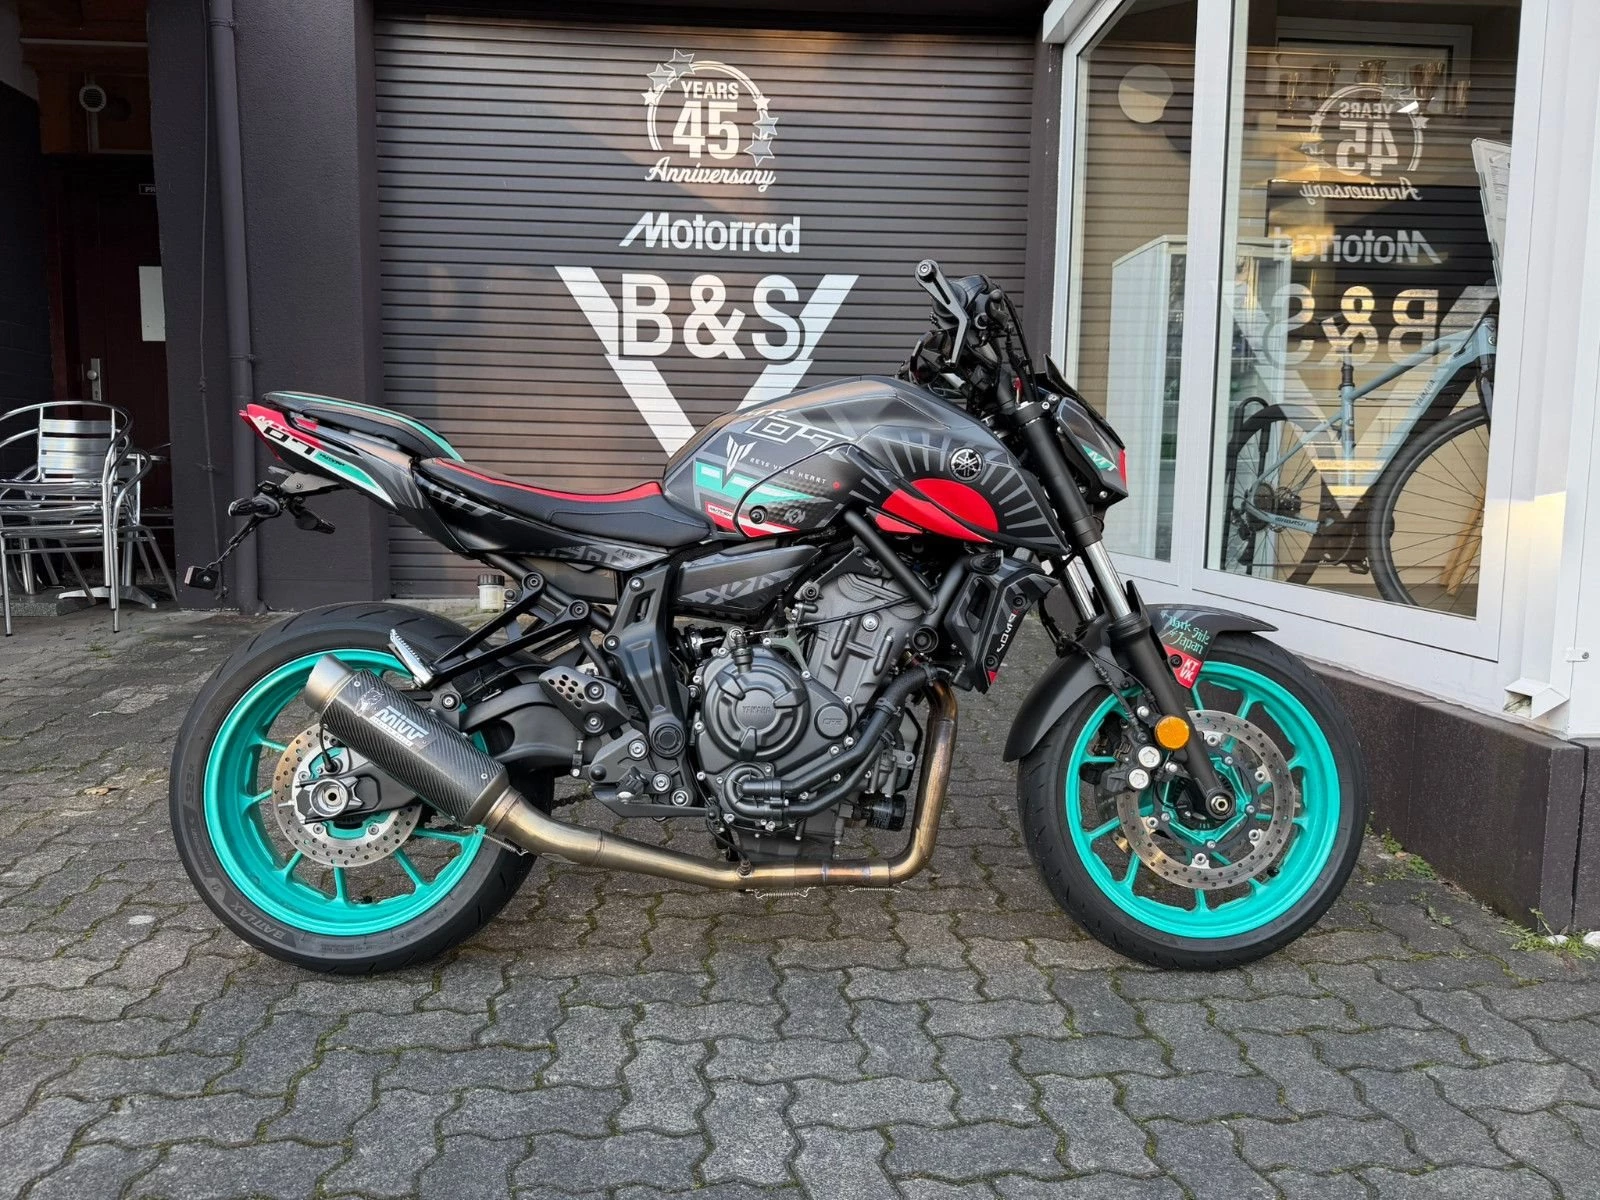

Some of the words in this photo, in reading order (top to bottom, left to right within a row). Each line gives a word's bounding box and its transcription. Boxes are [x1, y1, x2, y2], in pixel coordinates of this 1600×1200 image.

[681, 81, 739, 99] YEARS
[672, 101, 740, 160] 45
[644, 156, 776, 192] Anniversary
[618, 212, 801, 253] Motorrad
[622, 273, 802, 361] B&S
[1169, 631, 1204, 655] Japan
[231, 902, 288, 940] BATTLAX
